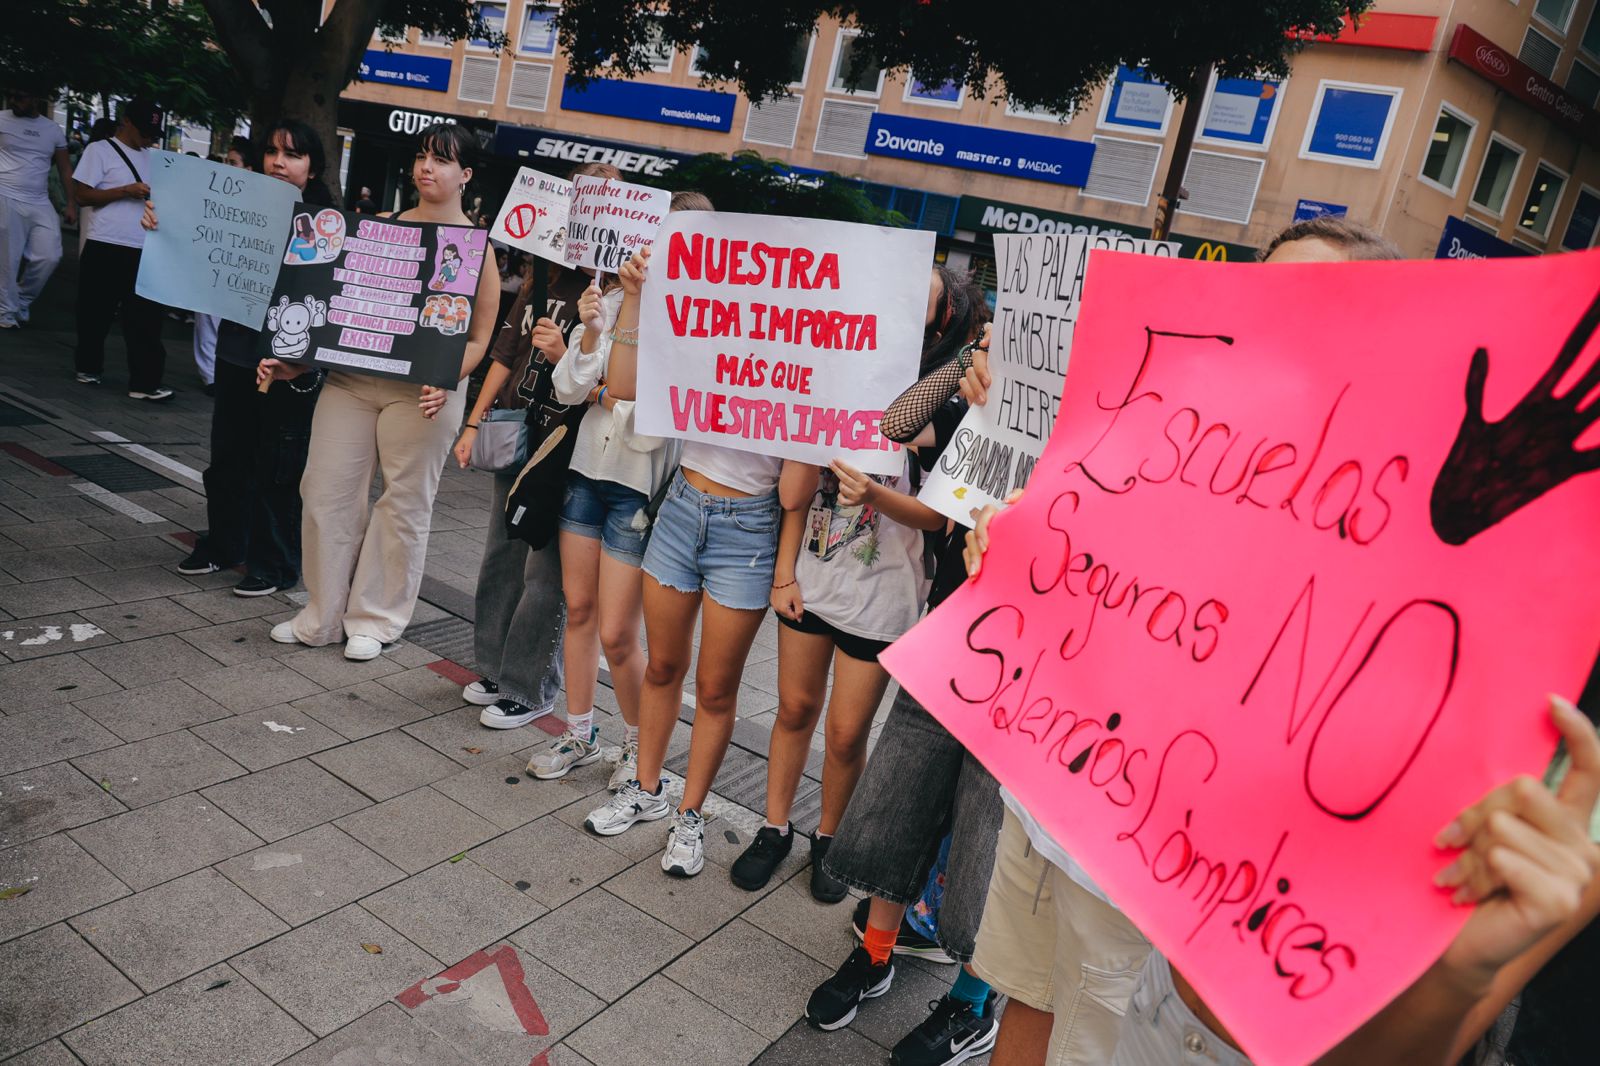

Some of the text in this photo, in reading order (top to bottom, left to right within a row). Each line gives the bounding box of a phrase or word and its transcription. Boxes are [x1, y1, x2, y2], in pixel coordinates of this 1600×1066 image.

[1478, 47, 1507, 73] SVENSON
[1526, 76, 1555, 105] Centro
[661, 107, 721, 123] Formación Abierta
[534, 137, 679, 176] SKECHERS
[875, 128, 944, 156] Davante
[1025, 161, 1062, 175] MEDAC
[208, 170, 246, 197] LOS
[520, 174, 535, 187] NO
[580, 198, 591, 215] la
[626, 189, 653, 202] no
[203, 199, 268, 228] PROFESORES
[192, 225, 224, 245] SON
[358, 219, 422, 247] SANDRA
[592, 226, 620, 247] CON
[208, 248, 270, 276] CULPABLES
[345, 252, 419, 279] CRUELDAD
[667, 231, 840, 290] NUESTRA
[1002, 236, 1032, 294] LAS
[327, 309, 348, 324] QUE
[350, 313, 384, 331] NUNCA
[665, 294, 877, 351] VIDA IMPORTA
[340, 328, 393, 353] EXISTIR
[1002, 302, 1078, 377] TAMBIÉ
[716, 353, 813, 395] MÁS QUE
[669, 386, 788, 442] VUESTRA
[1065, 326, 1409, 545] Escuelas
[940, 427, 1015, 501] SANDRA
[1030, 491, 1460, 822] Seguras NO
[950, 605, 1148, 807] Silencios
